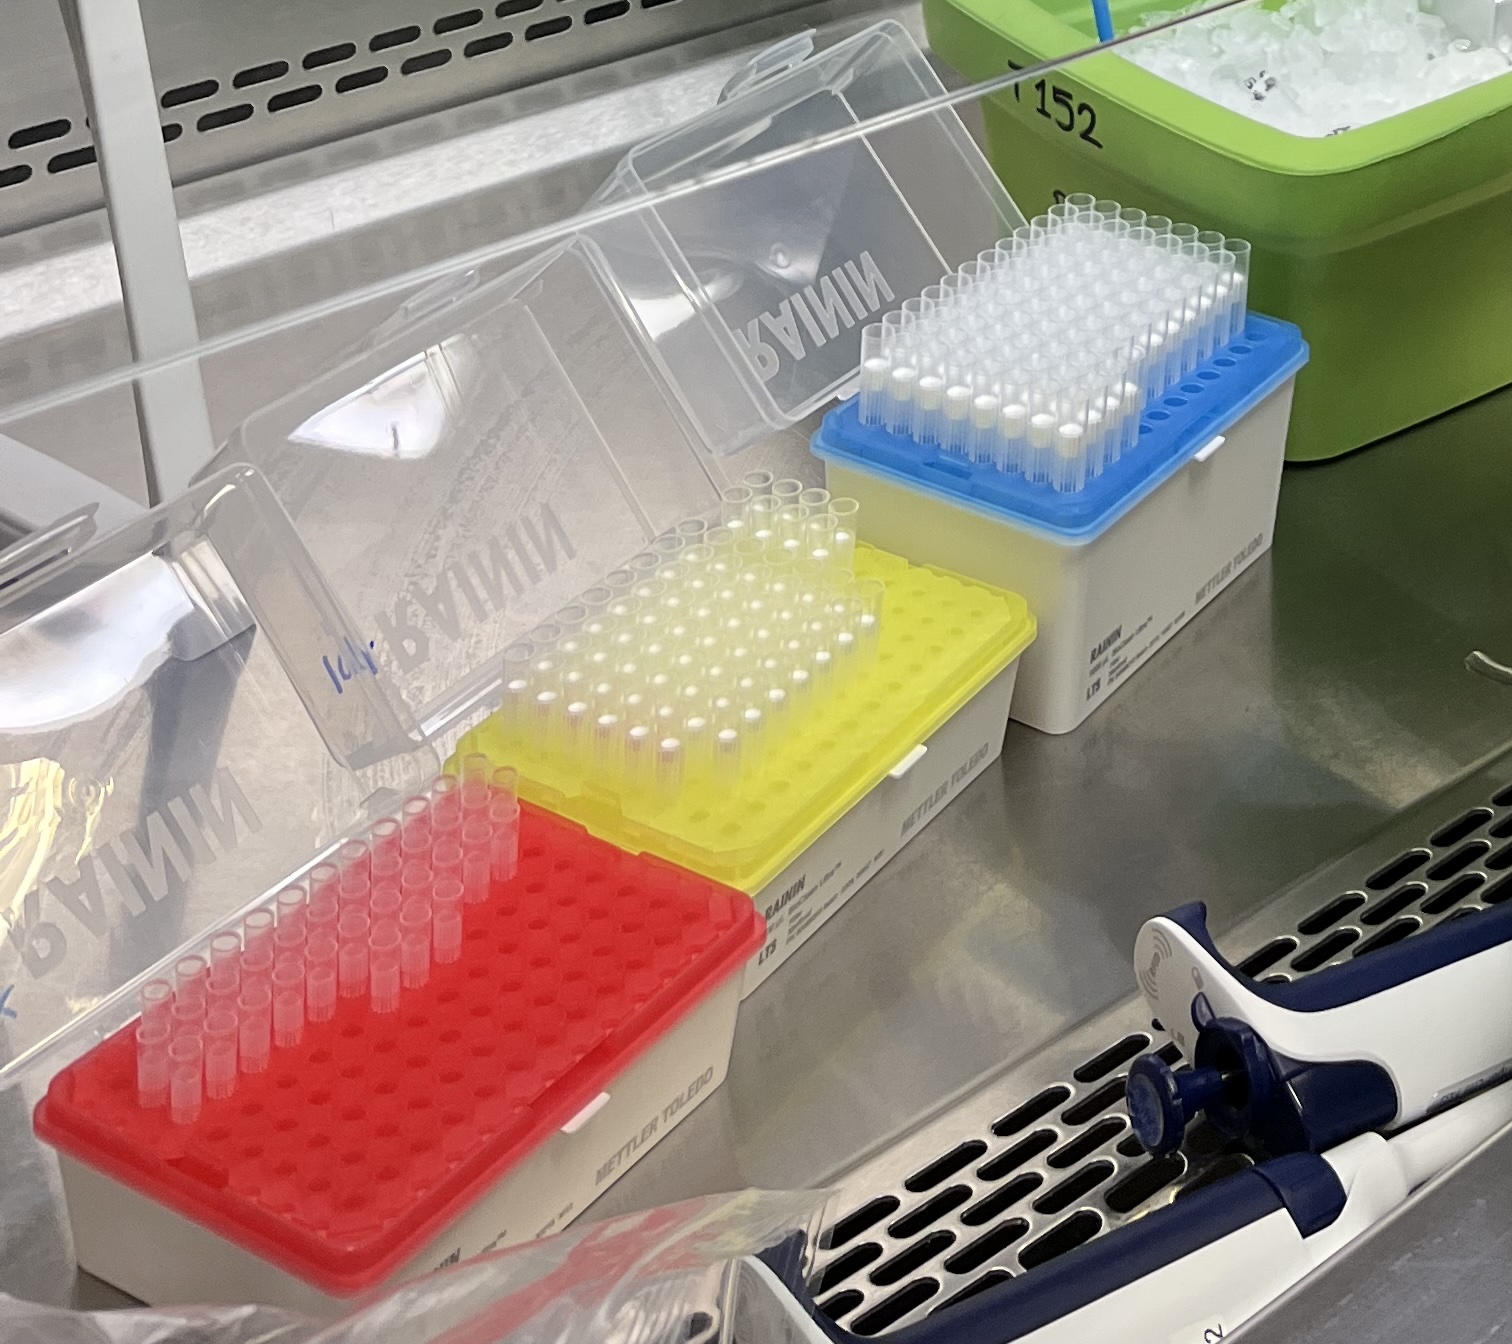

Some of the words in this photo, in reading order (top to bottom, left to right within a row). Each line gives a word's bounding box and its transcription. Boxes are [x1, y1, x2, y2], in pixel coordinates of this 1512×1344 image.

[900, 780, 949, 837] METTLER
[950, 741, 989, 787] TOLEDO
[764, 873, 807, 923] RAININ
[757, 937, 778, 967] LTS
[595, 1115, 659, 1187] METTLER
[661, 1065, 714, 1124] TOLEDO
